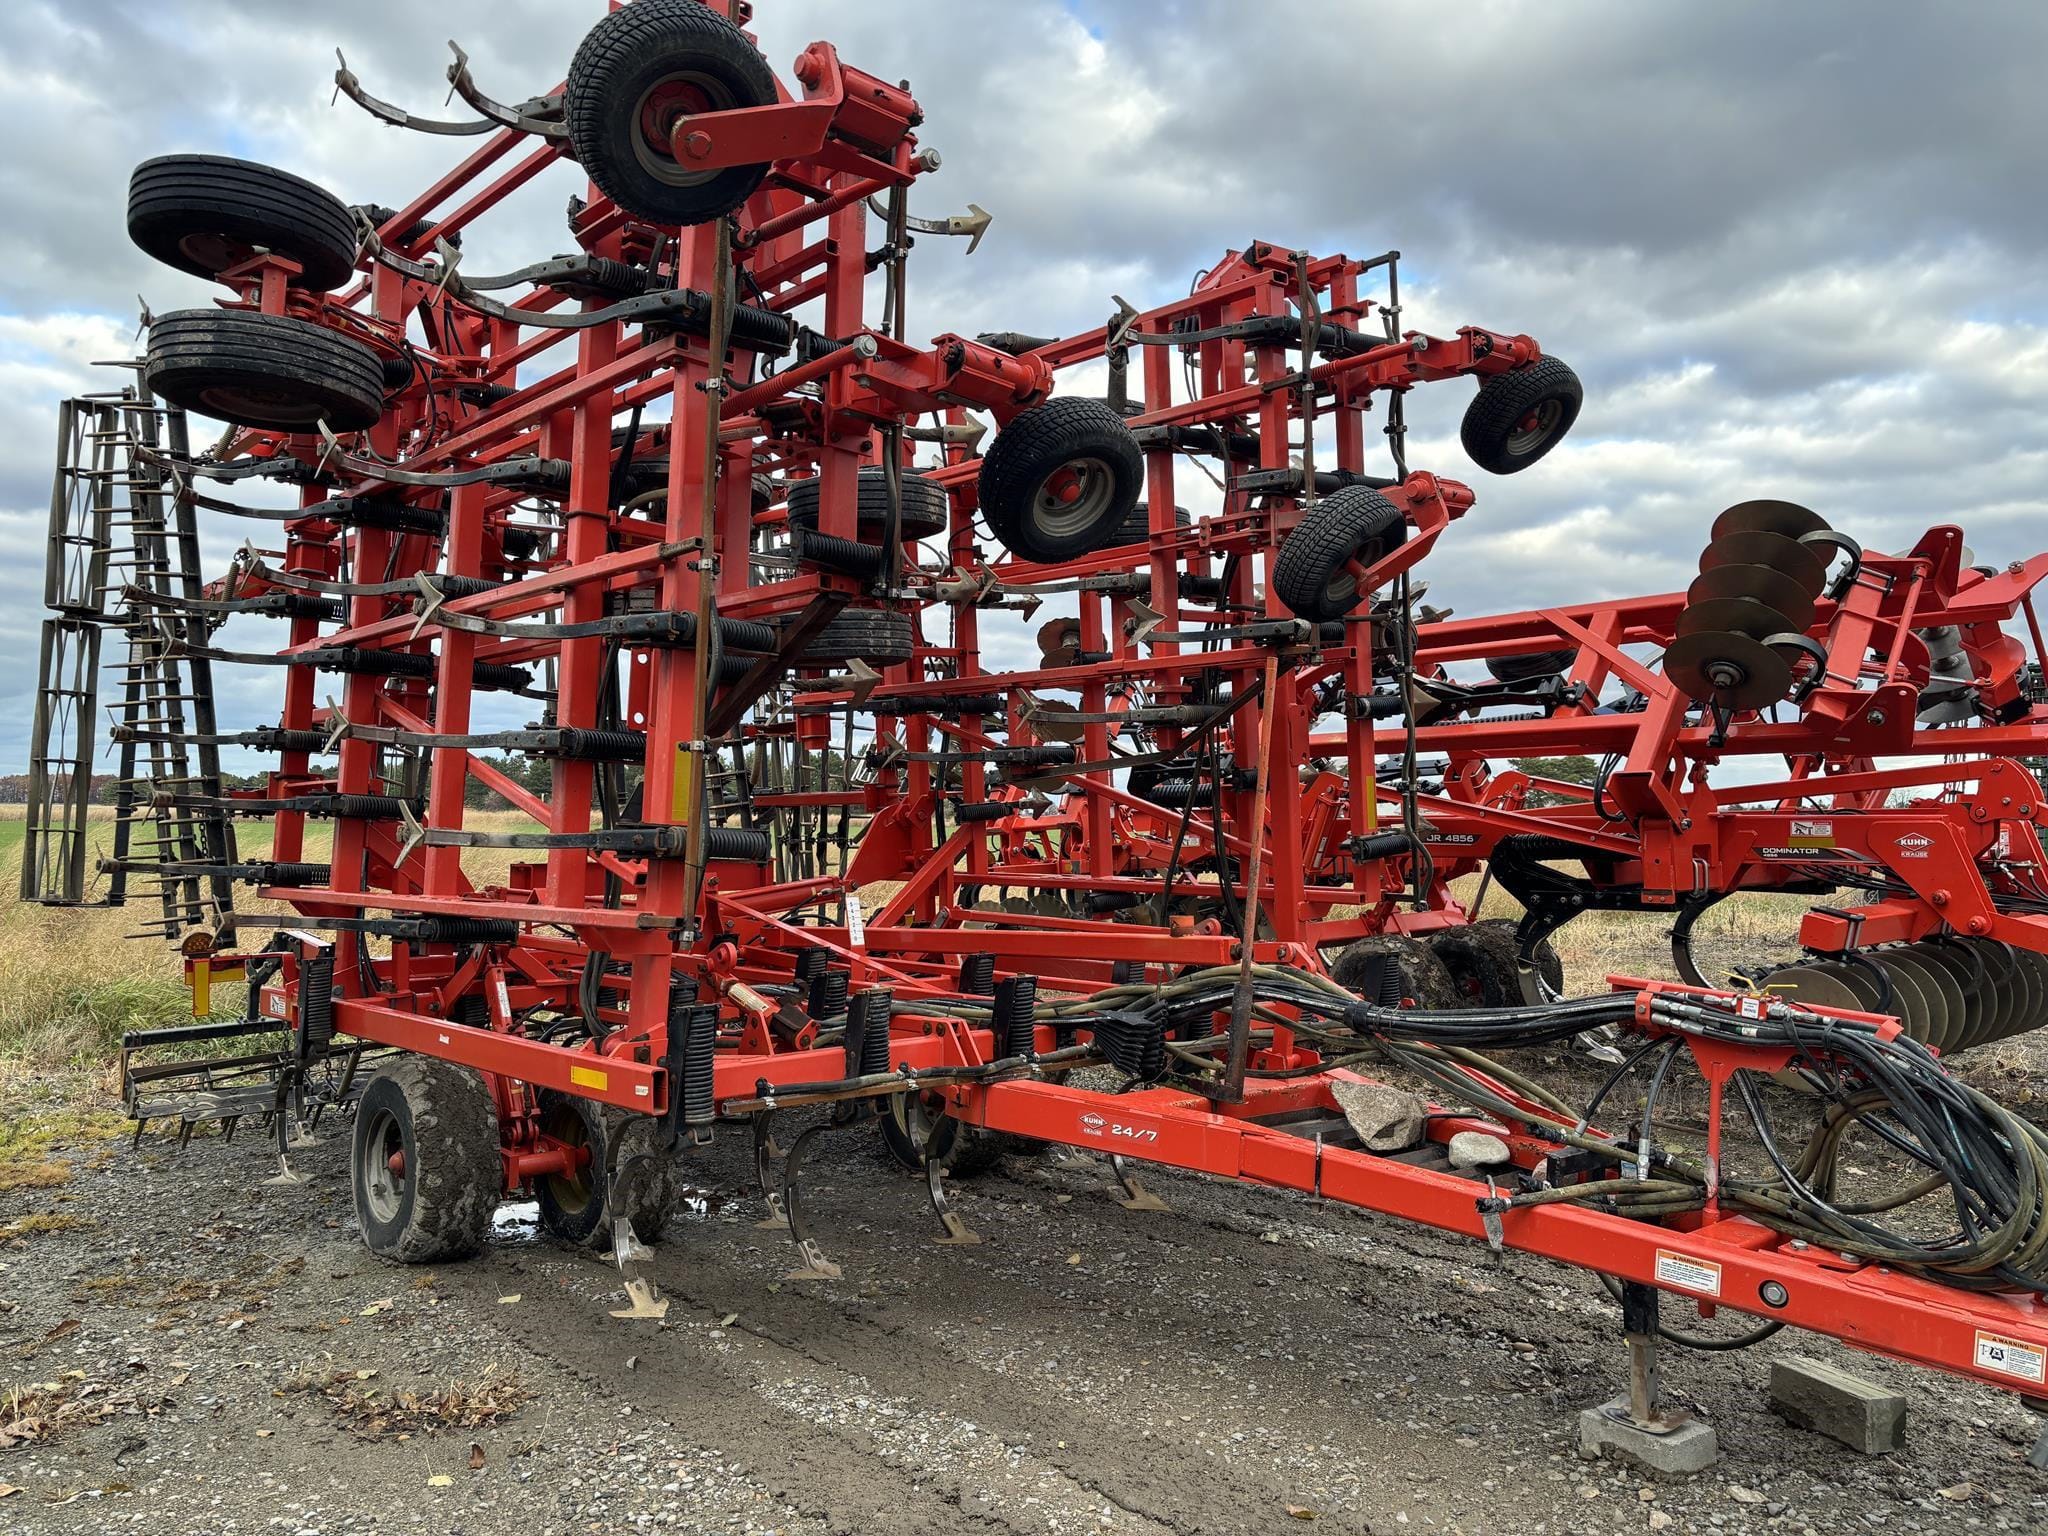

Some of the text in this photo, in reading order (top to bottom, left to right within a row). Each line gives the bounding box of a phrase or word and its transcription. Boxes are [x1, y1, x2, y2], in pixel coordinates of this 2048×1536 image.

[1444, 834, 1474, 843] 4856
[1900, 838, 1928, 846] KUHN
[1762, 847, 1819, 855] DOMINATOR
[1083, 1115, 1103, 1126] KUHN
[1111, 1124, 1158, 1142] 24/7
[1678, 1256, 1704, 1268] WARNING
[1998, 1337, 2029, 1350] WARNING
